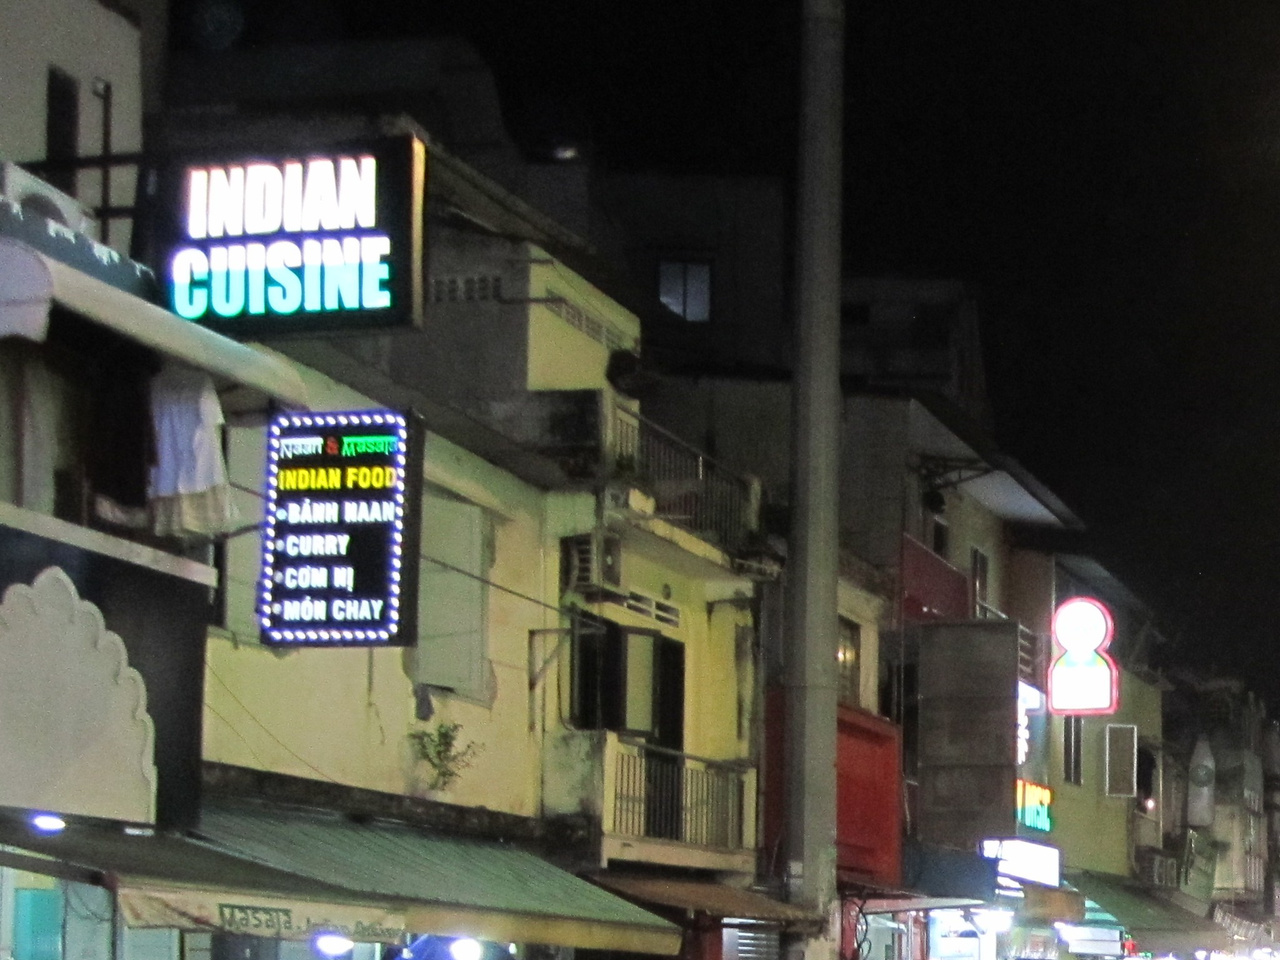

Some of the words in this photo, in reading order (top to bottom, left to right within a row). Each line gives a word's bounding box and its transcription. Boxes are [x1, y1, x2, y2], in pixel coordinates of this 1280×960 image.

[188, 155, 377, 240] INDIAN
[172, 236, 392, 320] CUISINE
[278, 468, 342, 491] INDIAN
[346, 466, 398, 490] FOOD
[287, 498, 340, 525] BÁNH
[343, 501, 396, 522] NAAN
[285, 534, 351, 556] CURRY
[284, 564, 329, 589] CƠM
[283, 596, 328, 621] MÓN
[331, 599, 384, 621] CHAY
